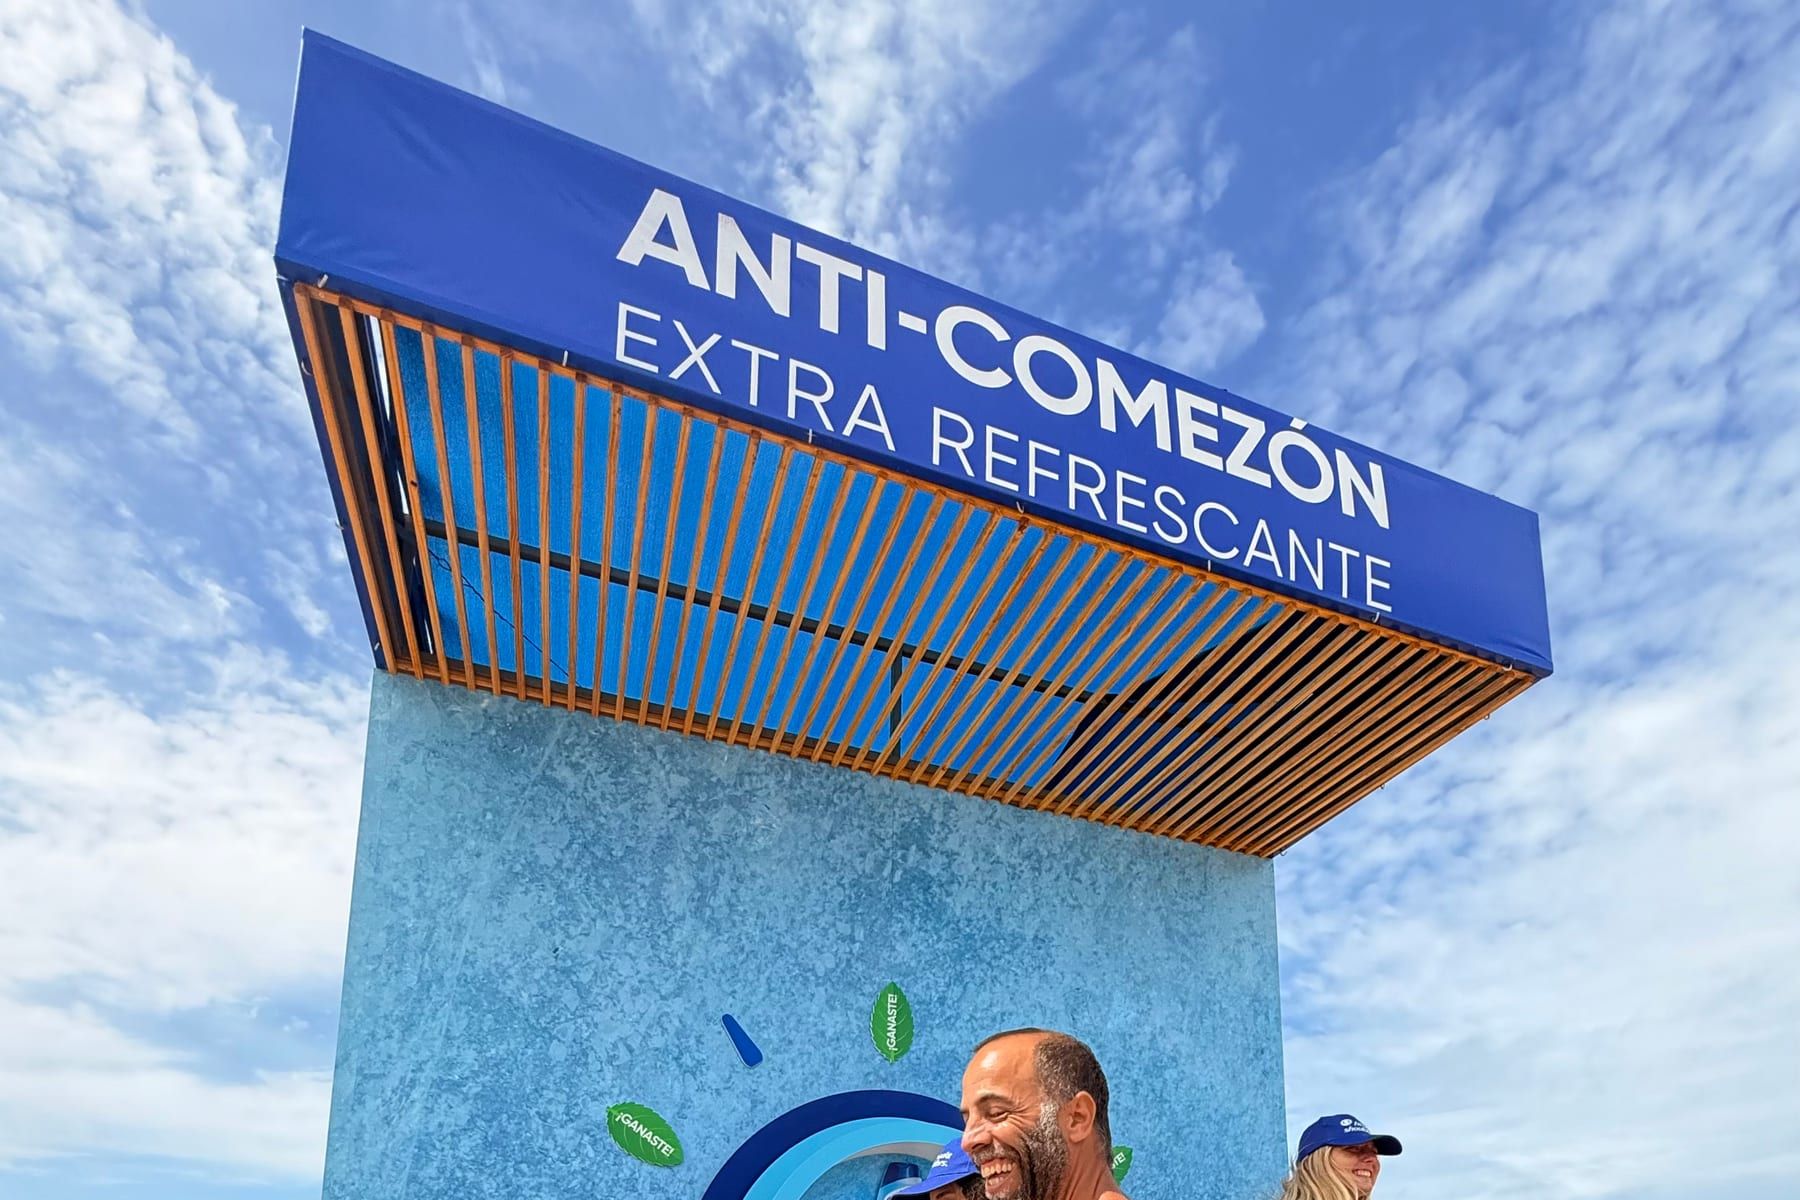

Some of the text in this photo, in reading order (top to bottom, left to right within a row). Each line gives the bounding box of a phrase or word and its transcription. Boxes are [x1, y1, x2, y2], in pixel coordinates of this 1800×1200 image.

[615, 187, 1390, 530] ANTI-COMEZÓN
[615, 301, 1392, 613] EXTRA REFRESCANTE
[615, 1112, 675, 1157] ¡GANASTE!
